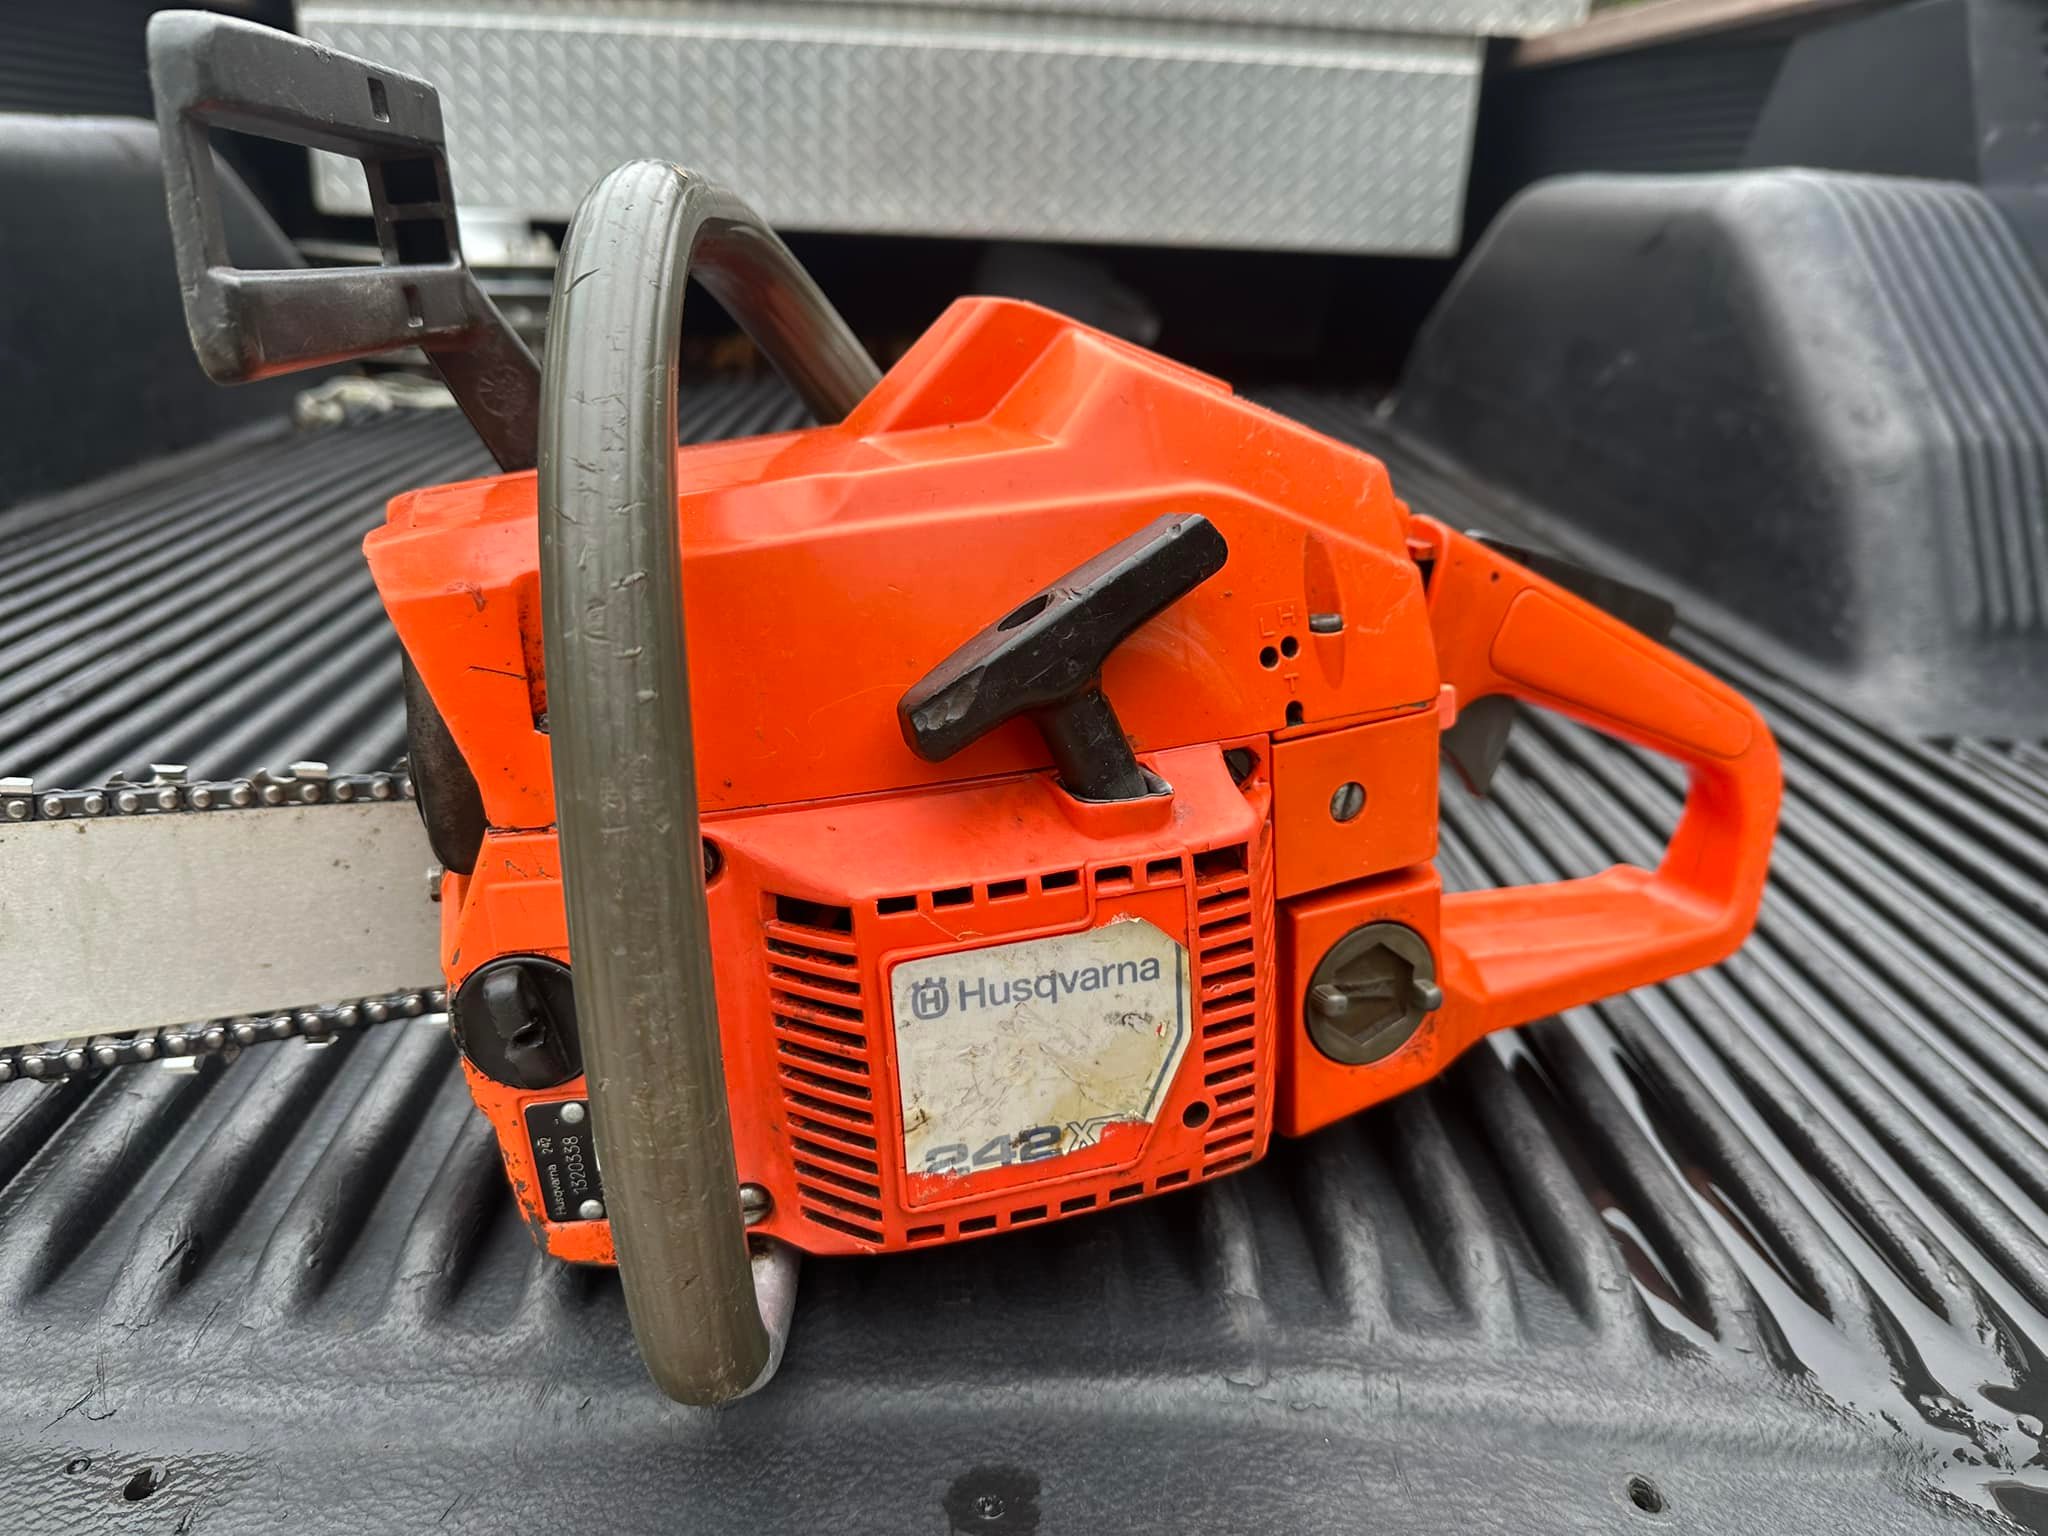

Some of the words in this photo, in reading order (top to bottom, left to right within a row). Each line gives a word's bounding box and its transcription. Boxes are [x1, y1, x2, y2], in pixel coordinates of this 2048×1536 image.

[1259, 615, 1276, 639] L
[1278, 604, 1297, 627] H
[1283, 671, 1300, 694] T
[958, 956, 1161, 1012] Husqvarna
[539, 1136, 554, 1154] 242
[561, 1135, 589, 1195] 1320338
[548, 1164, 568, 1216] Husqvarna
